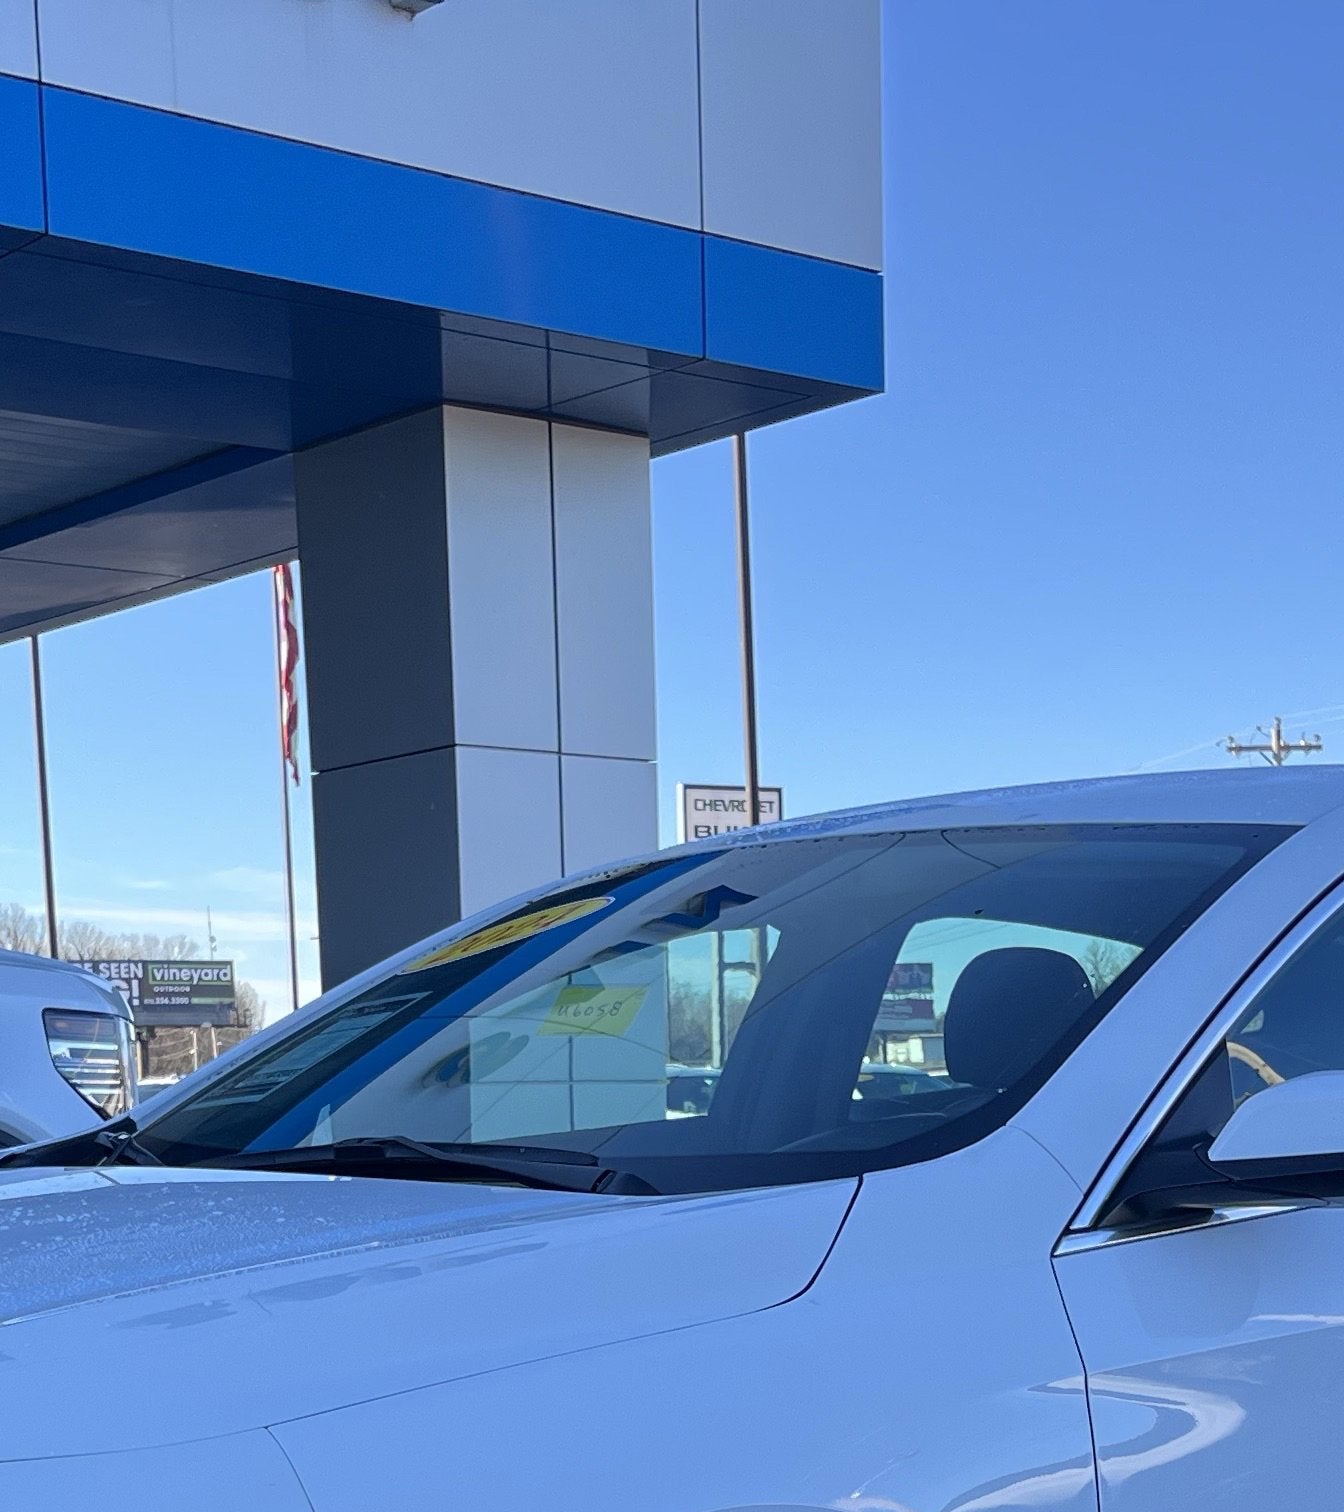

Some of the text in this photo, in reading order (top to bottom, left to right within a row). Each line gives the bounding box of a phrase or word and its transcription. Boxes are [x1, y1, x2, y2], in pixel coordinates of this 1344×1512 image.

[694, 798, 775, 814] CHEVRET
[98, 962, 144, 979] SEEN
[153, 964, 232, 985] vineyard
